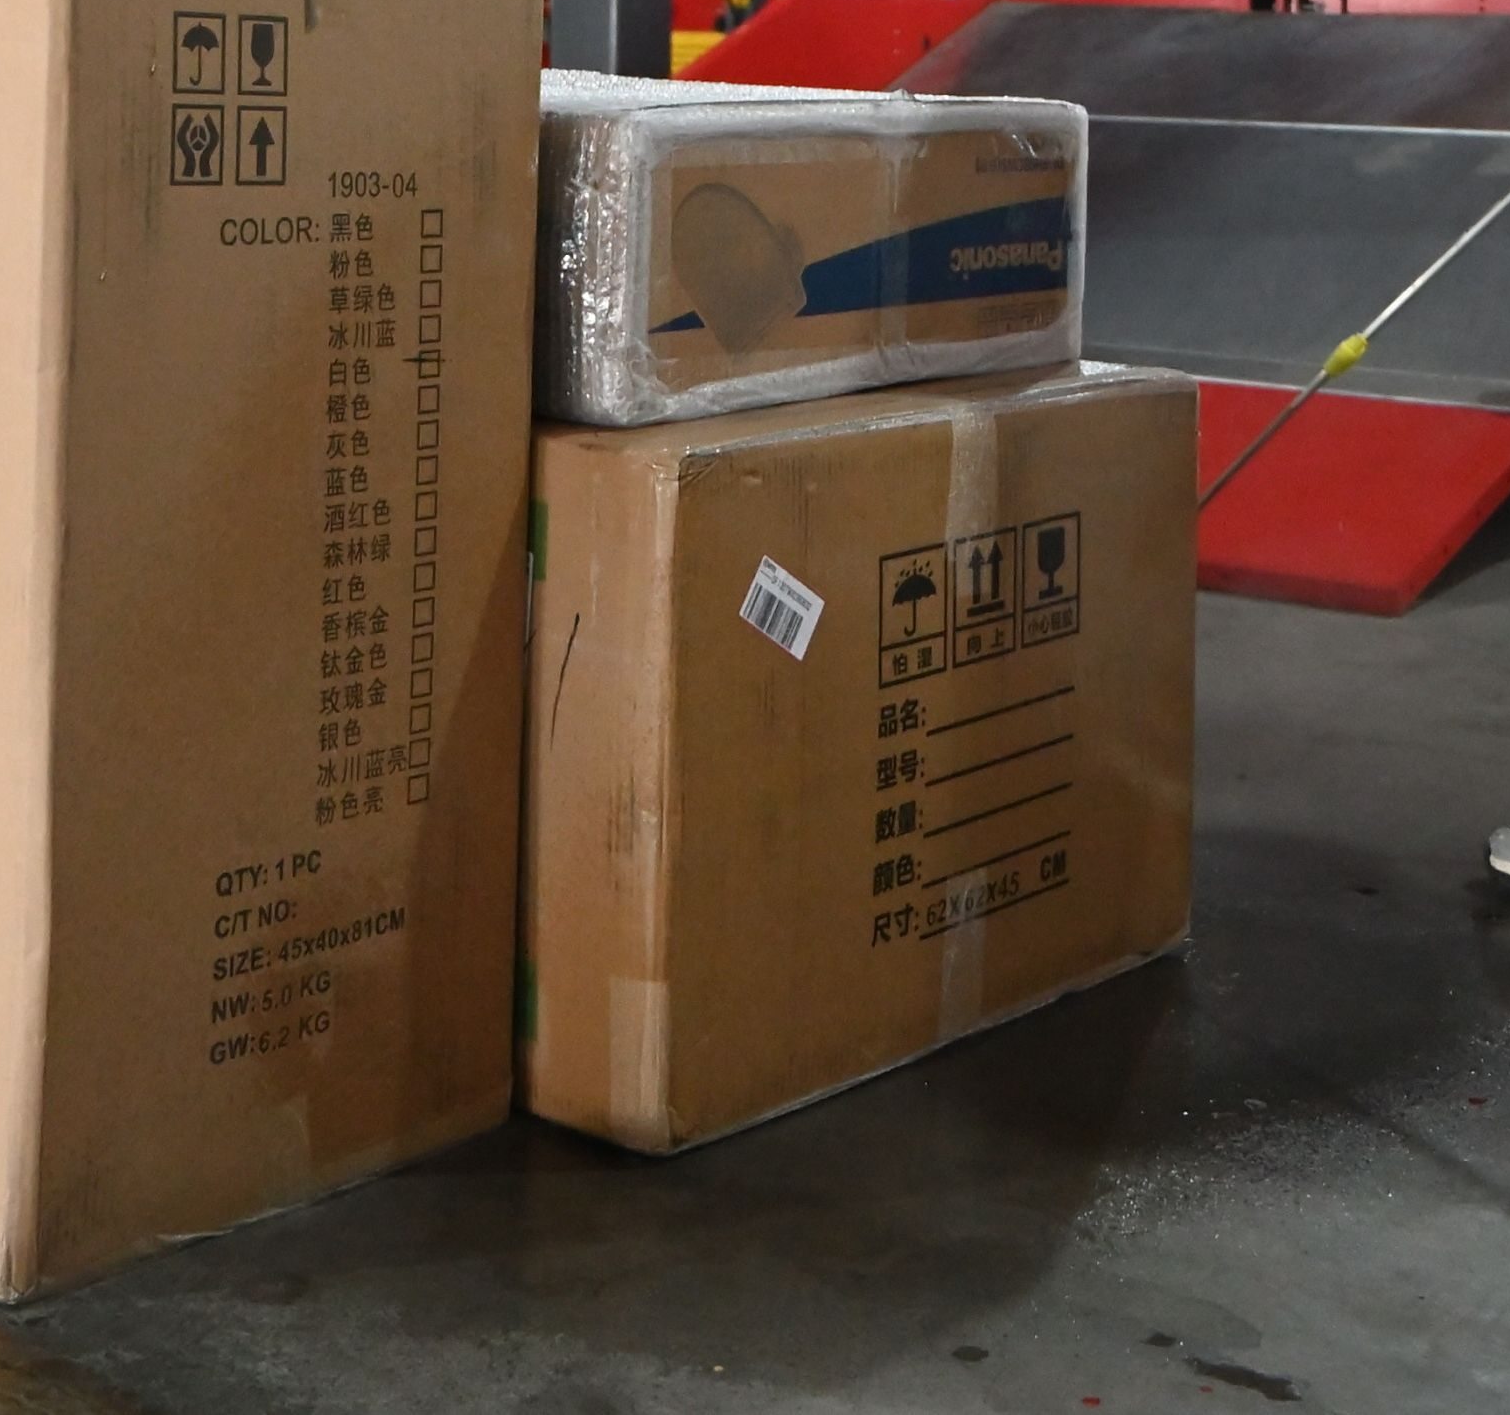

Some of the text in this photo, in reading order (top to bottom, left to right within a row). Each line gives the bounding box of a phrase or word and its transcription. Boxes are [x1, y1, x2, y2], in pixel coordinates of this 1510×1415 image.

[328, 171, 419, 198] 1903-04
[220, 212, 374, 246] COLOR: 黑色
[329, 249, 374, 279] 粉色
[950, 238, 1064, 281] Panasonic
[329, 284, 396, 315] 草绿色
[328, 318, 397, 350] 冰川蓝
[328, 356, 372, 387] 白色
[326, 390, 372, 424] 橙色
[326, 426, 371, 459] 灰色
[324, 465, 369, 498] 蓝色
[323, 497, 391, 536] 酒红色
[323, 533, 391, 570] 森林绿
[321, 573, 366, 607] 红色
[321, 605, 389, 644] 香槟金
[967, 627, 1005, 655] 向上
[320, 642, 388, 680] 钛金色
[319, 676, 387, 717] 玫瑰金
[318, 718, 362, 753] 银色
[316, 745, 407, 789] 冰川蓝亮
[315, 786, 384, 826] 粉色亮
[215, 850, 322, 897] QTY: 1 PC
[1040, 850, 1068, 882] CM
[214, 899, 298, 939] C/T NO:
[212, 946, 272, 982] SIZE:
[211, 970, 332, 1024] NW: 5.0 KG
[298, 1011, 331, 1039] KG
